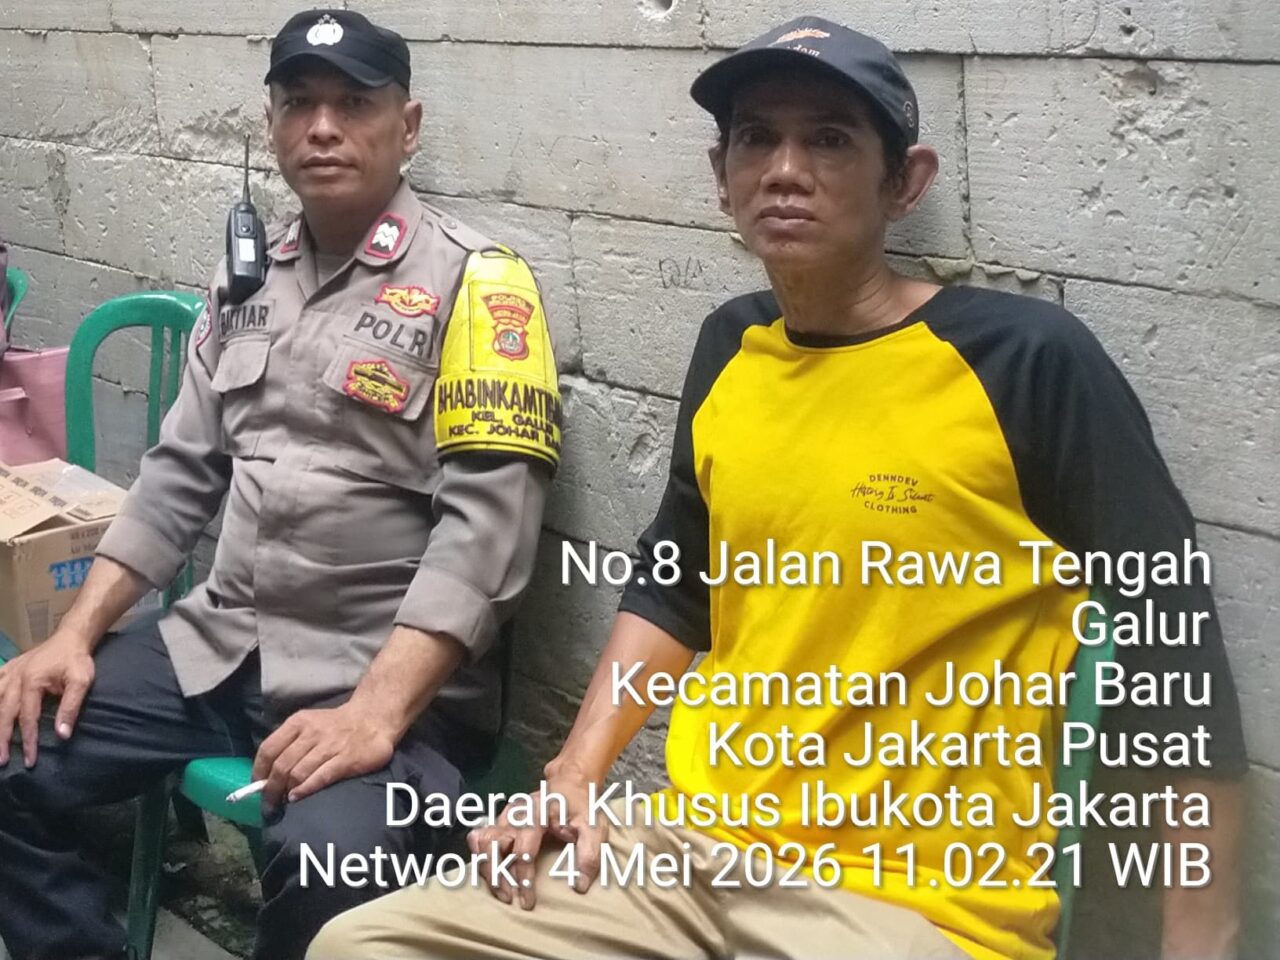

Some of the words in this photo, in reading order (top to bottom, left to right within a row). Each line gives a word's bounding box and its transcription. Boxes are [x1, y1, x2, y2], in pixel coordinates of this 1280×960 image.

[448, 423, 480, 437] KEC.
[486, 423, 539, 441] JOHAR
[863, 500, 918, 515] CLOTHING
